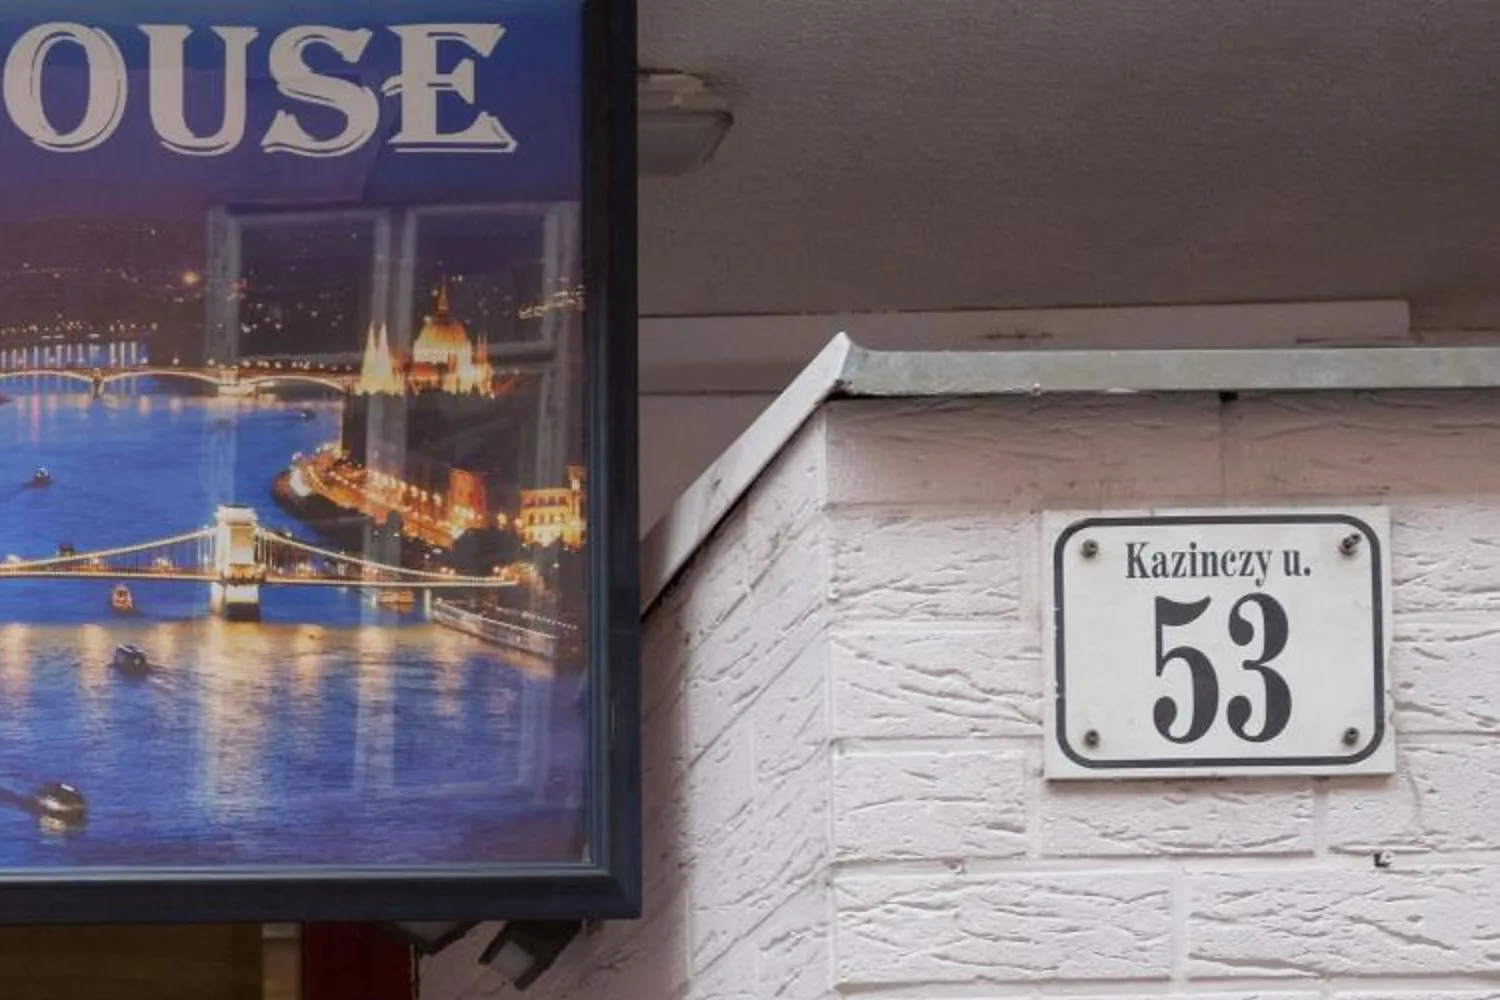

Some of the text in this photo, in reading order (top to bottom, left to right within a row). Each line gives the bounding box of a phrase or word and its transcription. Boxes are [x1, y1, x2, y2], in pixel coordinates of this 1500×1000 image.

[1125, 541, 1311, 587] Kazinczy u.
[1152, 591, 1293, 745] 53
